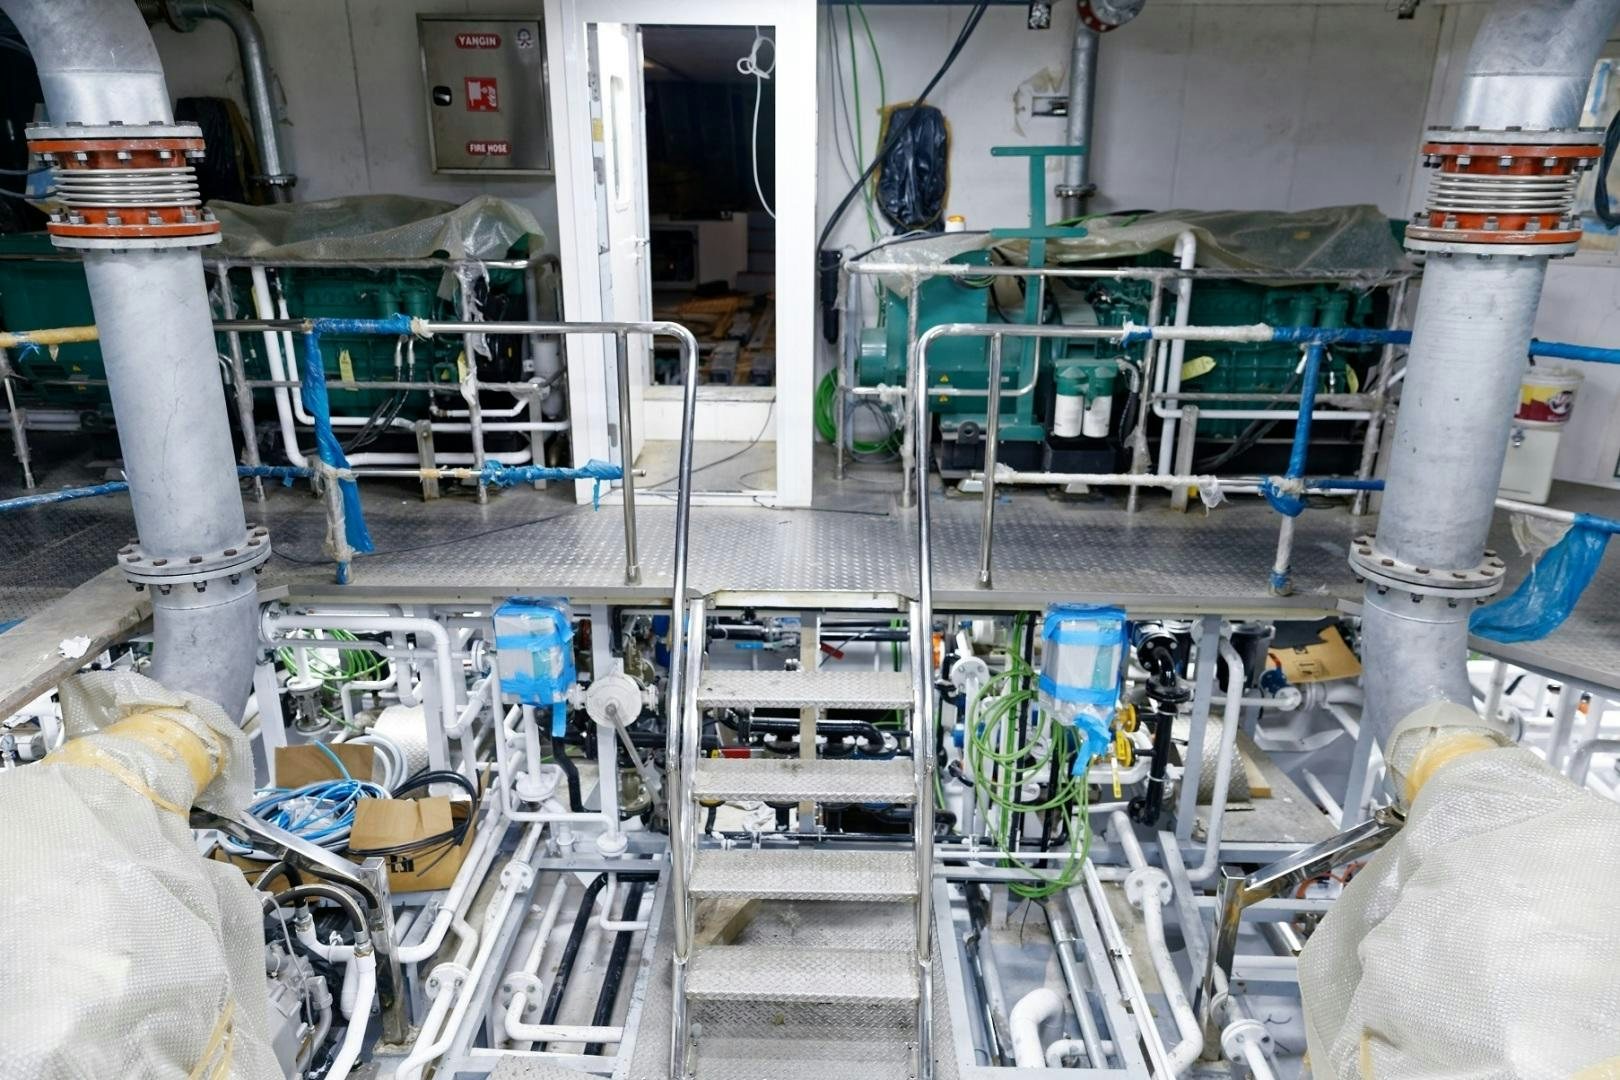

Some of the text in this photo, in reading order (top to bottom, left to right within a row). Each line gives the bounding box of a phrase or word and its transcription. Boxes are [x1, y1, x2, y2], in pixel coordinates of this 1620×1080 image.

[458, 36, 497, 46] YANGIN
[470, 143, 507, 153] FIRE HOSE
